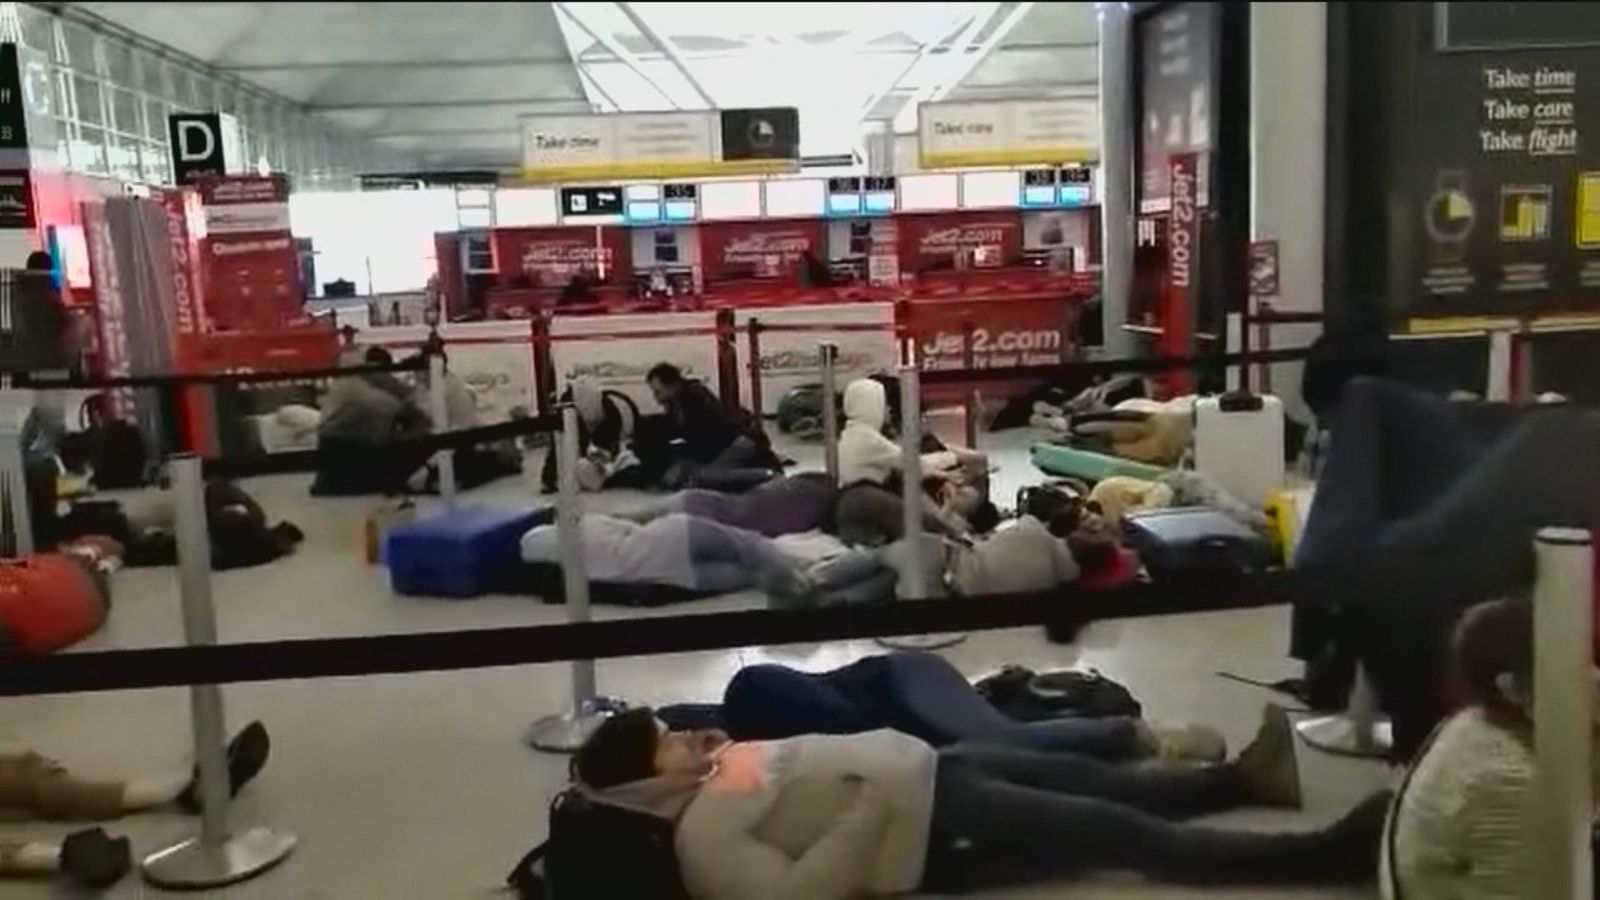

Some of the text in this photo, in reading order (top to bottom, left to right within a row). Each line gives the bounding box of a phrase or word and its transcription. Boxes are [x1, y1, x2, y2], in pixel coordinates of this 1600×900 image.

[1484, 67, 1576, 94] Take time
[1483, 99, 1575, 124] Take care
[177, 120, 215, 162] D
[535, 134, 568, 150] Take
[1480, 128, 1577, 156] Take flight
[920, 228, 1003, 244] Jet2.com
[1170, 161, 1193, 287] Jet2.com
[723, 234, 809, 253] Jet2.com
[164, 197, 193, 333] Jet2.com
[923, 328, 1061, 355] Je2.com
